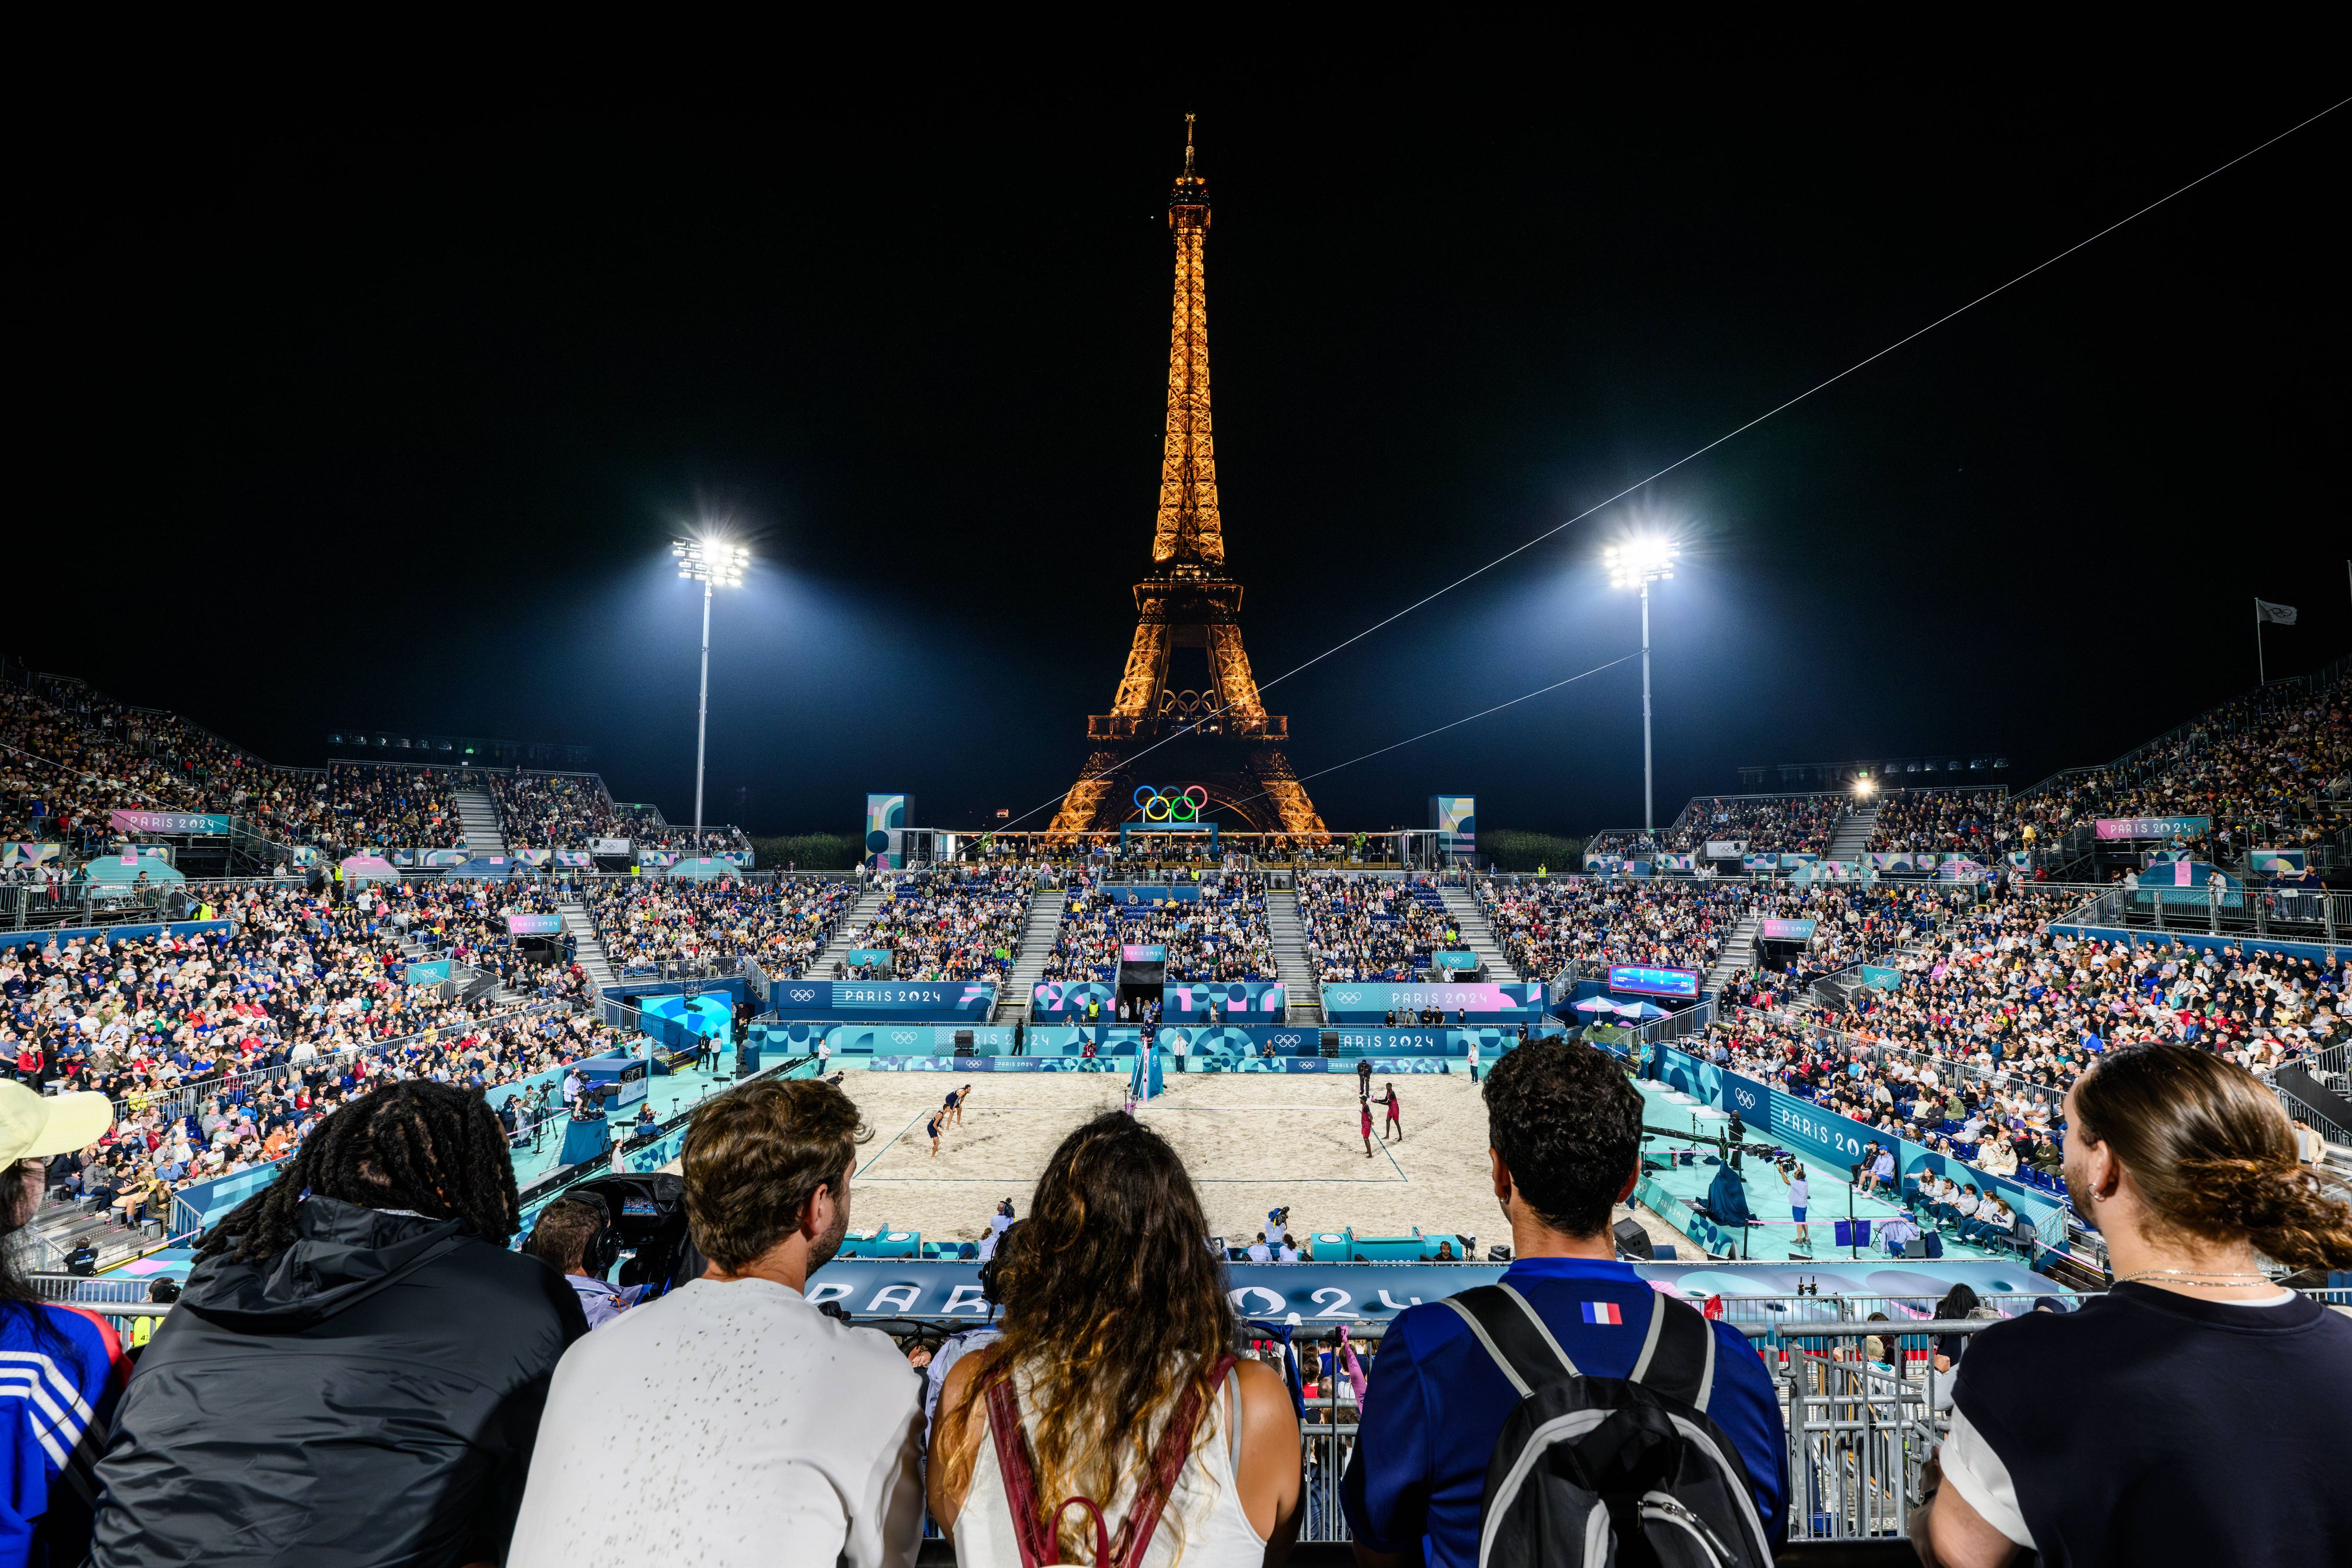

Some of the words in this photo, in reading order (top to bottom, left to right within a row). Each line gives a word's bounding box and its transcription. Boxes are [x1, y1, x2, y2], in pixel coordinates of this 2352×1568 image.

[179, 818, 214, 828] 2024
[2153, 823, 2191, 833] 2024
[898, 991, 940, 1002] 2024
[1445, 992, 1487, 1004] 2024
[1389, 1035, 1434, 1047] 2024
[1835, 1132, 1870, 1156] 20
[1672, 1208, 1688, 1223] 2024
[804, 1282, 988, 1313] PAR
[1229, 1286, 1423, 1318] 024
